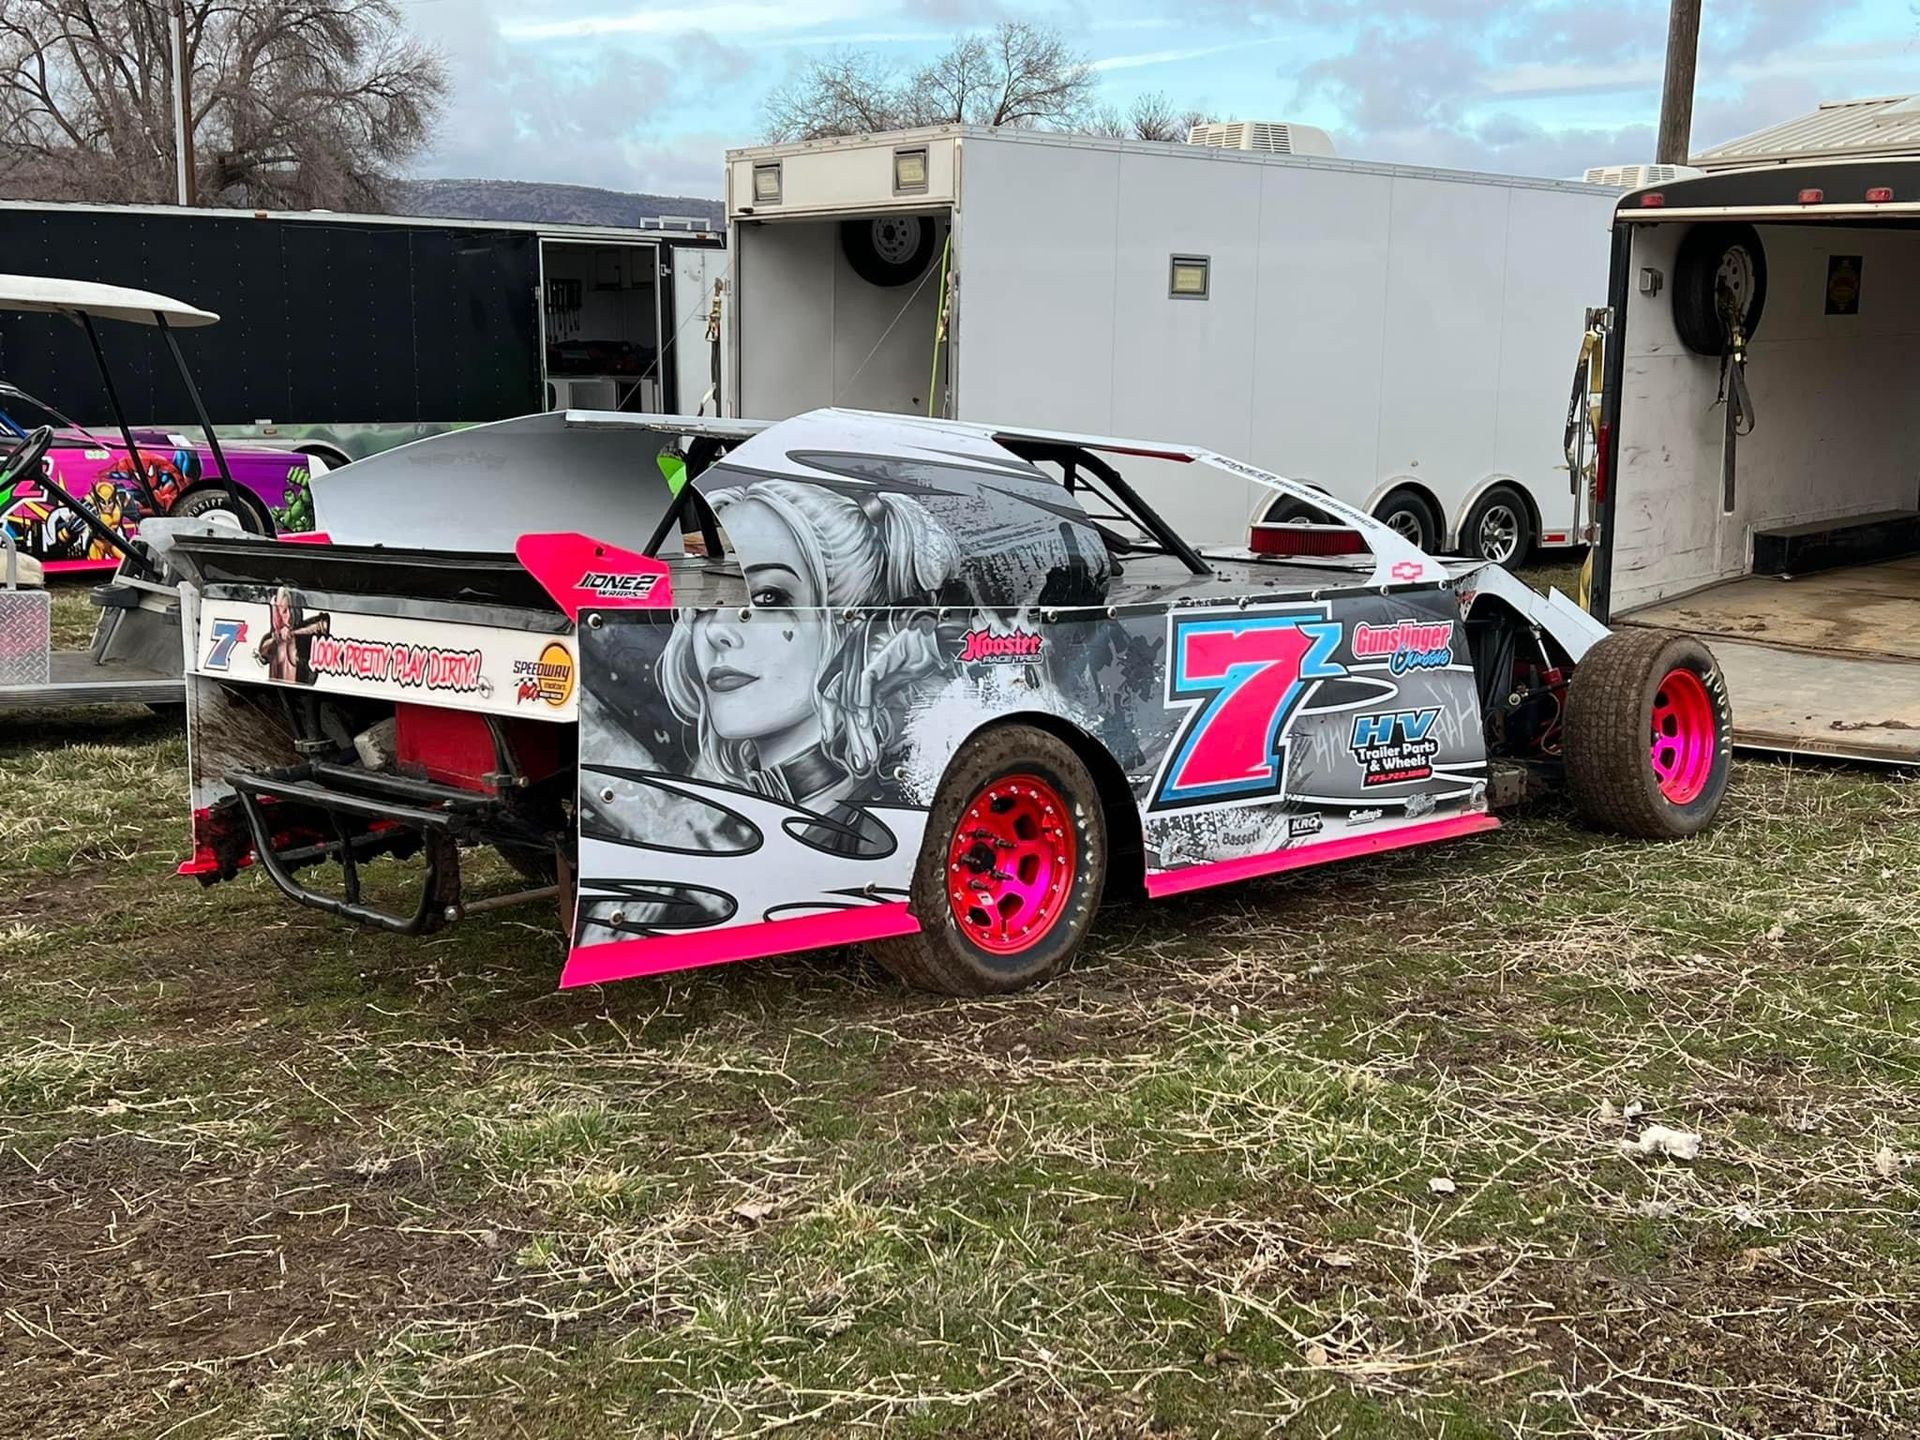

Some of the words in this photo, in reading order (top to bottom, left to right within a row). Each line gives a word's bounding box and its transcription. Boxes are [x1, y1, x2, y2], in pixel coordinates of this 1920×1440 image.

[959, 623, 1043, 662] Hoosier
[1354, 622, 1451, 656] Gunslinger
[309, 636, 343, 675] LOOK
[343, 639, 392, 681] PRETTY
[391, 643, 428, 687] PLAY
[427, 647, 482, 692] DIRTY!
[513, 660, 570, 682] SPEEDWAY
[1353, 709, 1437, 749] HV
[1358, 746, 1399, 761] Trailer
[1403, 742, 1435, 756] Parts
[1370, 761, 1380, 772] &
[1383, 755, 1426, 770] Wheels
